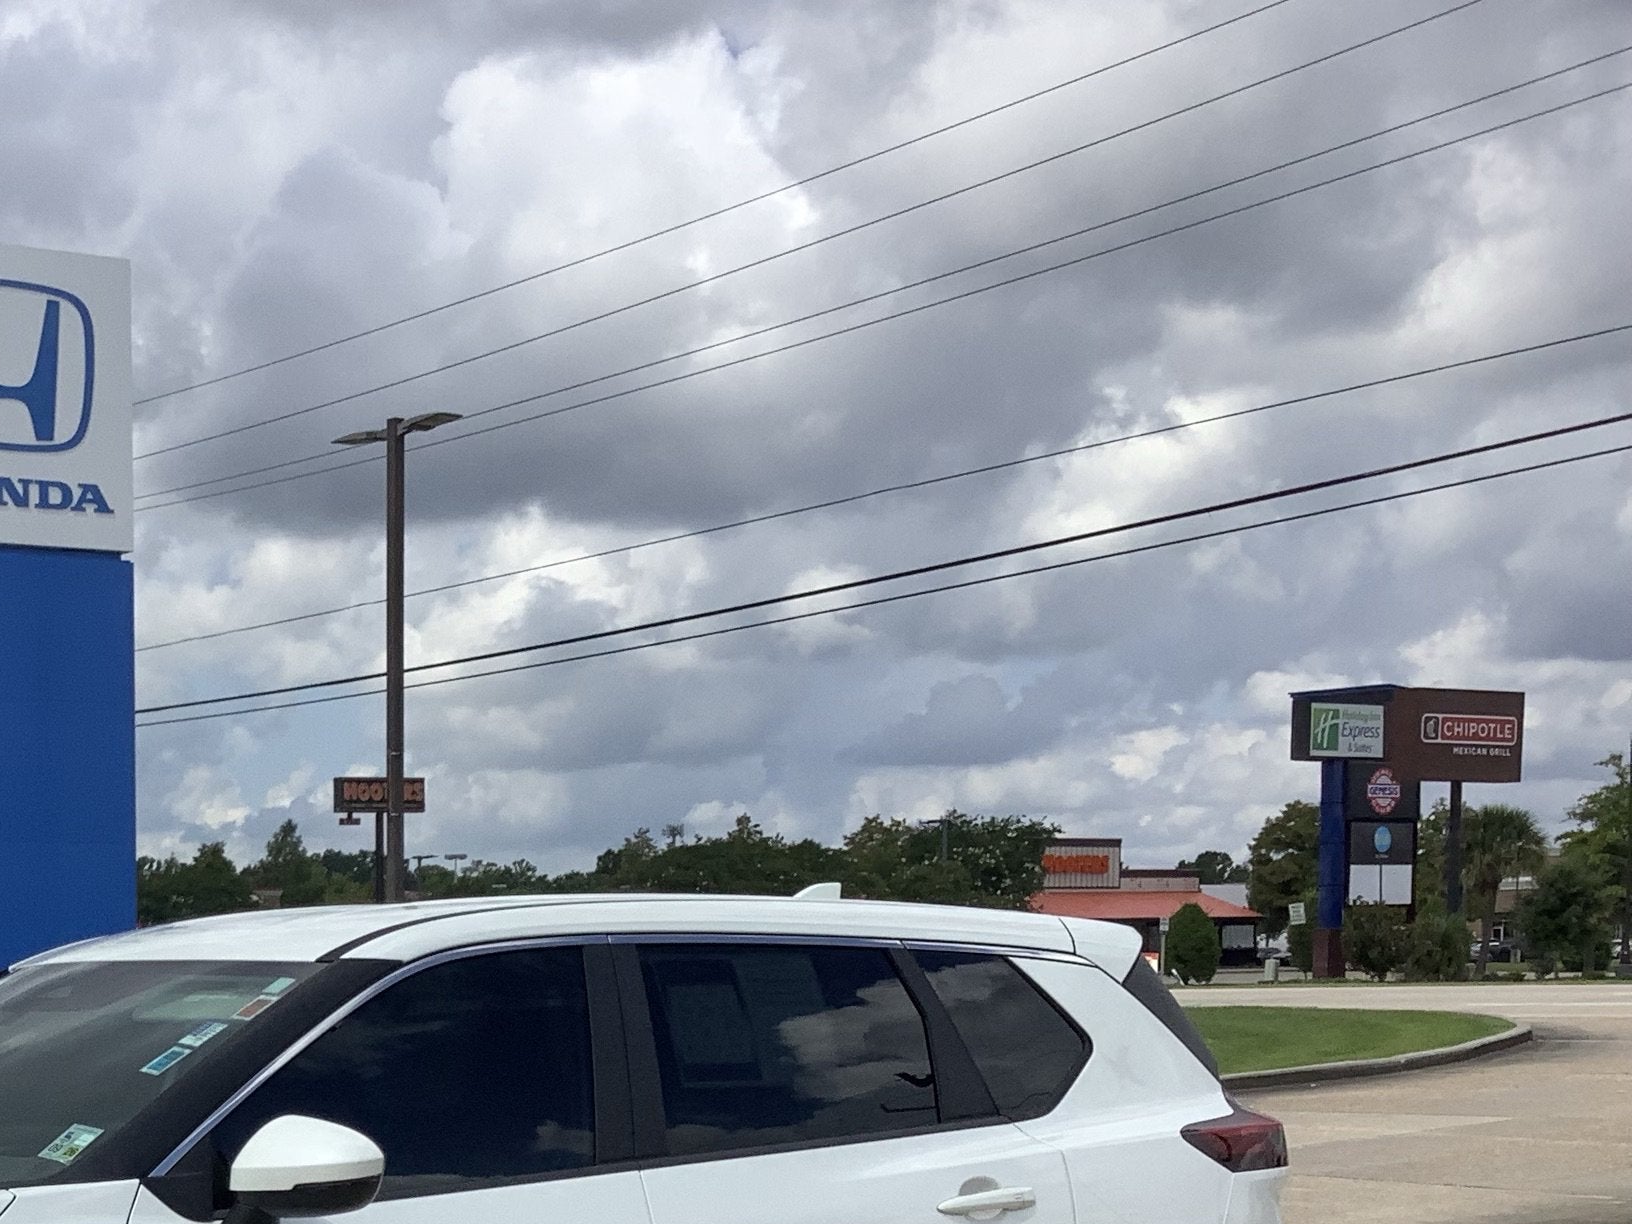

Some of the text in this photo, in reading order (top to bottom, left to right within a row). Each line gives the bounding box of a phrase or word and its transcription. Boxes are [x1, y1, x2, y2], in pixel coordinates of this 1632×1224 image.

[1341, 722, 1381, 741] Express
[1443, 721, 1513, 739] CHIPOTLE
[1453, 747, 1511, 757] MEXICAN GRILL
[1369, 786, 1399, 795] GENESIS
